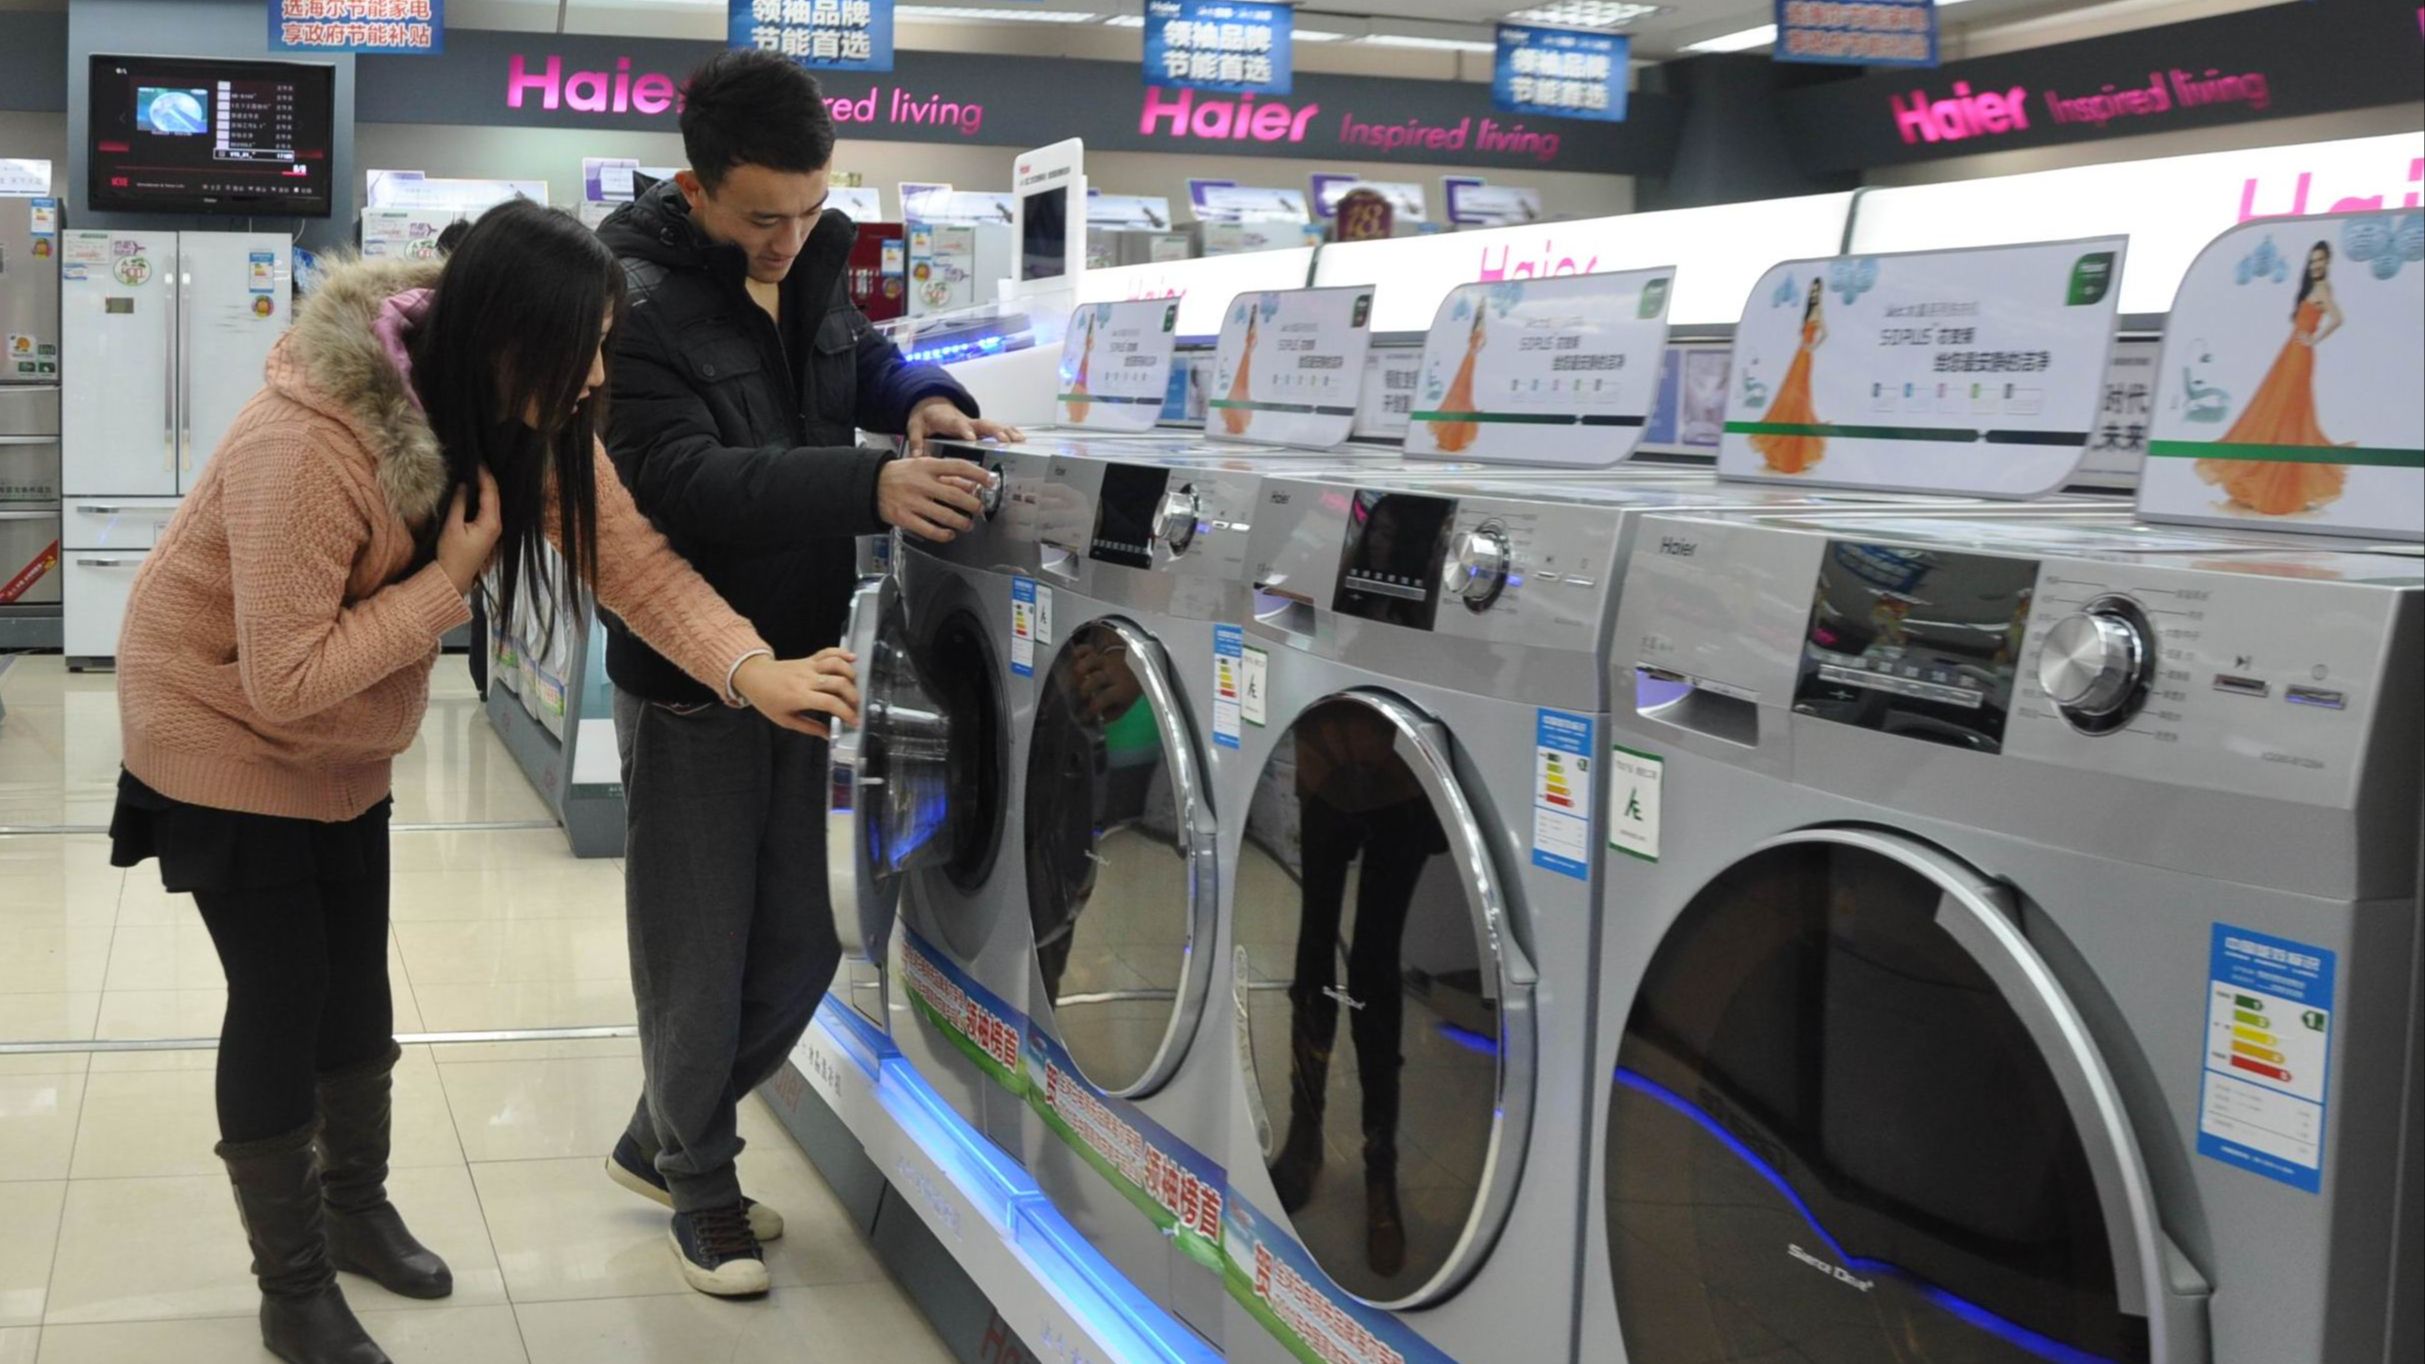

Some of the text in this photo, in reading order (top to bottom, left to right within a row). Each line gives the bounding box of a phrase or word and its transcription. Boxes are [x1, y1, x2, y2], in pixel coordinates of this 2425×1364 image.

[282, 0, 431, 20] 选海尔节能家电
[752, 0, 871, 27] 领袖品牌
[282, 22, 432, 47] 享政府节能补贴
[751, 26, 871, 60] 节能首选
[1163, 20, 1272, 52] 领袖品牌
[1162, 50, 1272, 82] 节能首选
[508, 54, 688, 115] Haie
[891, 87, 984, 136] living
[1890, 67, 2272, 144] Haier Inspired living
[1139, 86, 1561, 162] Haier Inspired living
